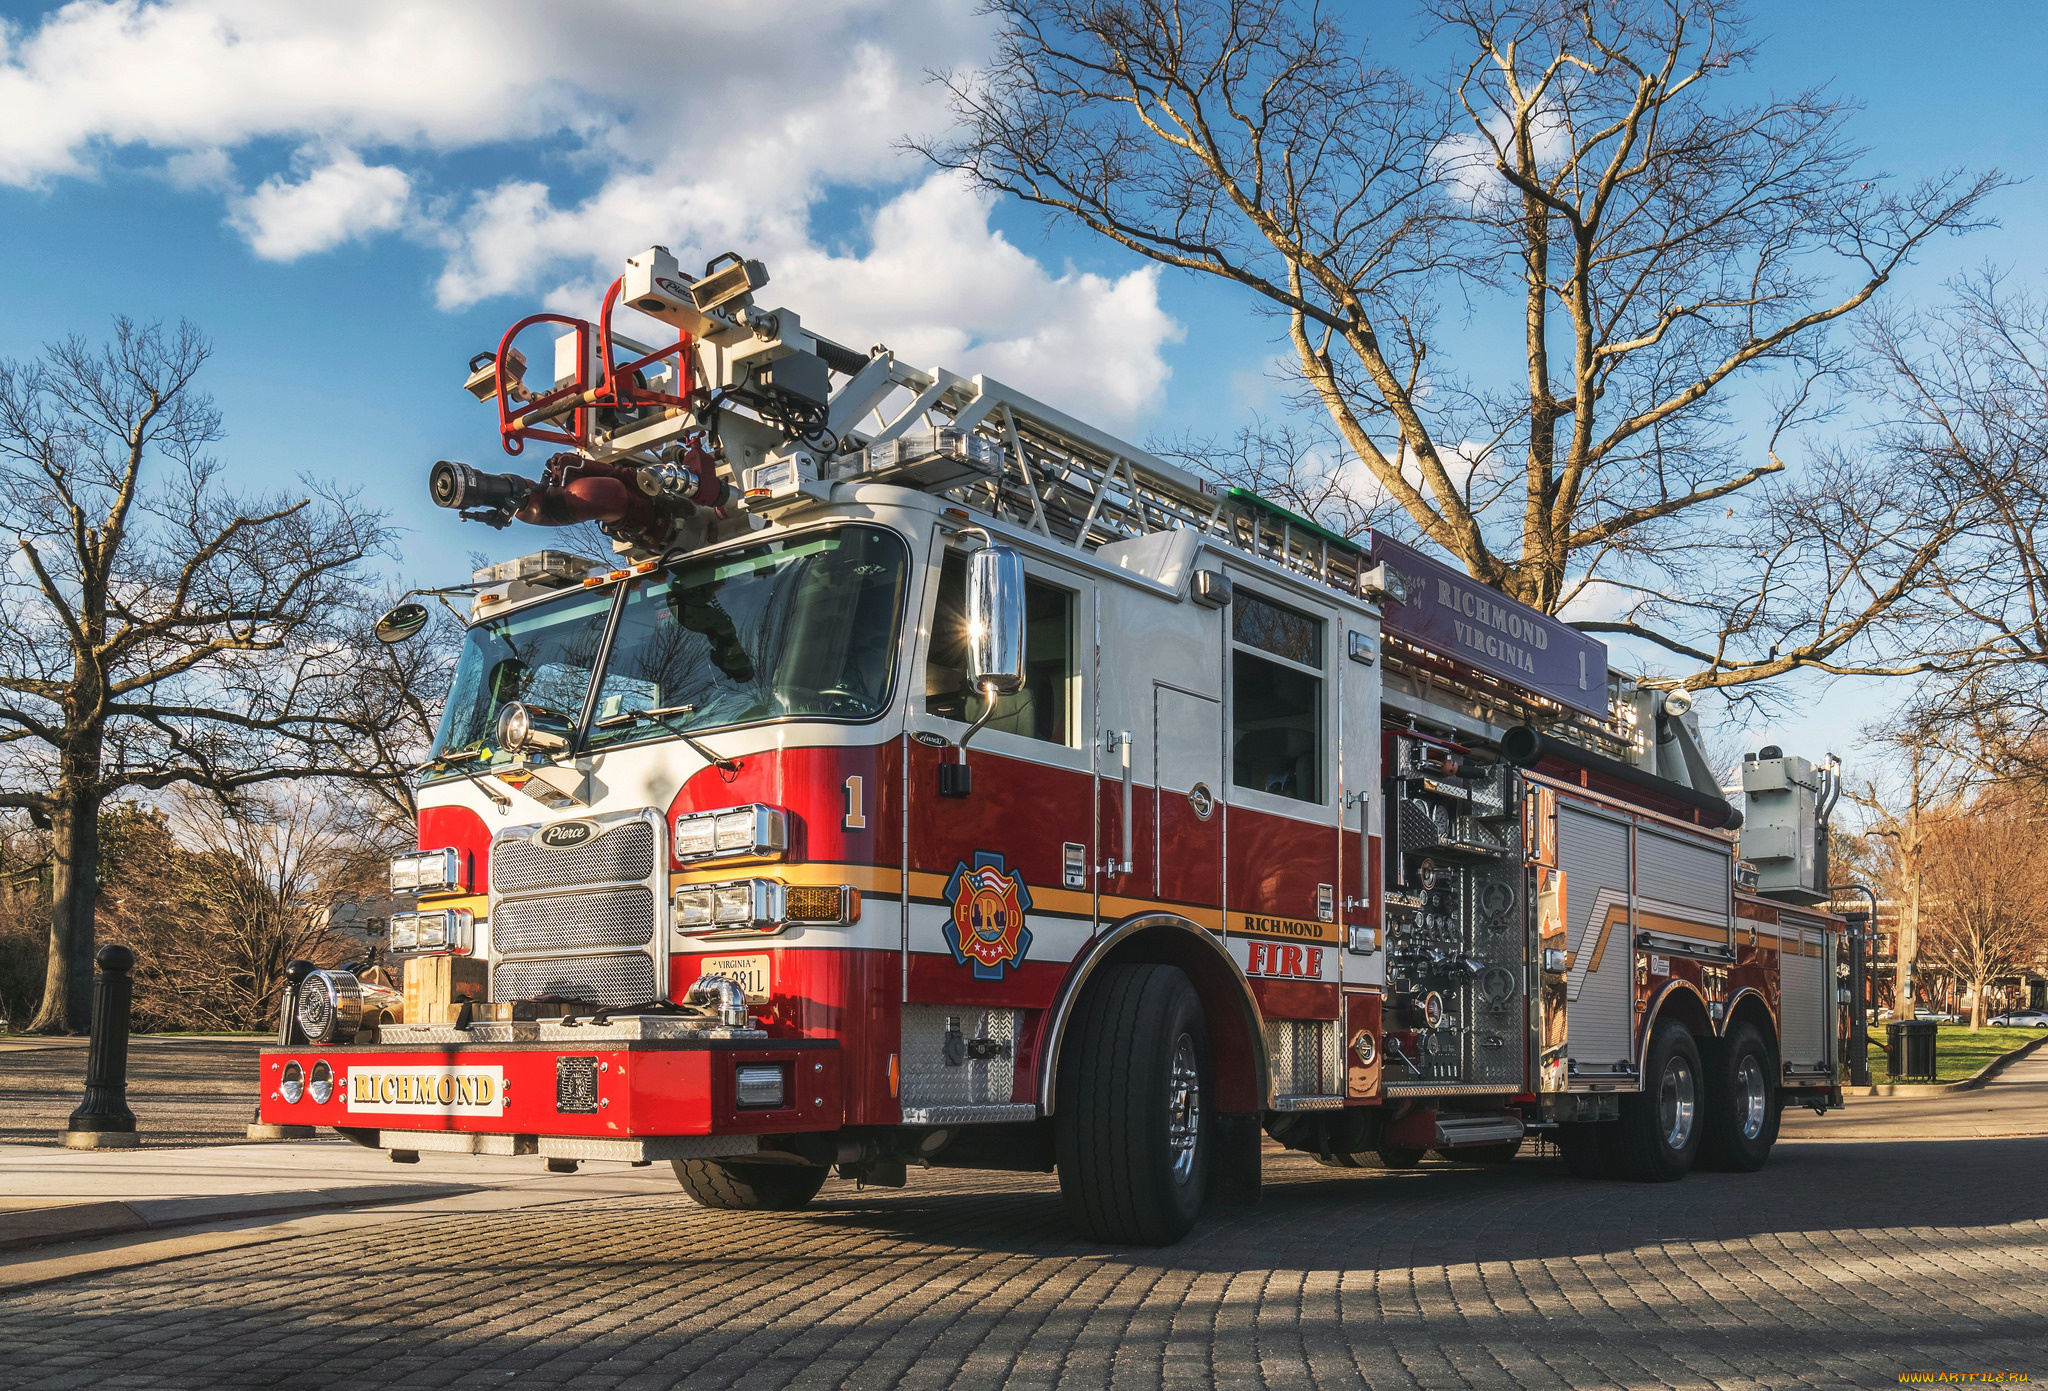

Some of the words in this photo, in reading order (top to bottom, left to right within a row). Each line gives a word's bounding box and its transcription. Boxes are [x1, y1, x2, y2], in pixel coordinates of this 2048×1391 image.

[665, 281, 694, 299] Pierc
[1205, 483, 1217, 496] 105
[1437, 578, 1548, 650] RICHMOND
[1453, 619, 1535, 674] VIRGINIA
[1578, 650, 1587, 691] 1
[841, 775, 866, 833] 1
[546, 825, 585, 844] Pierce
[959, 904, 969, 922] F
[980, 897, 1001, 933] R
[1009, 909, 1019, 928] D
[1244, 916, 1323, 938] RICHMOND
[718, 959, 751, 969] VIRGINIA
[1245, 940, 1323, 980] FIRE
[354, 1074, 495, 1106] RICHMOND
